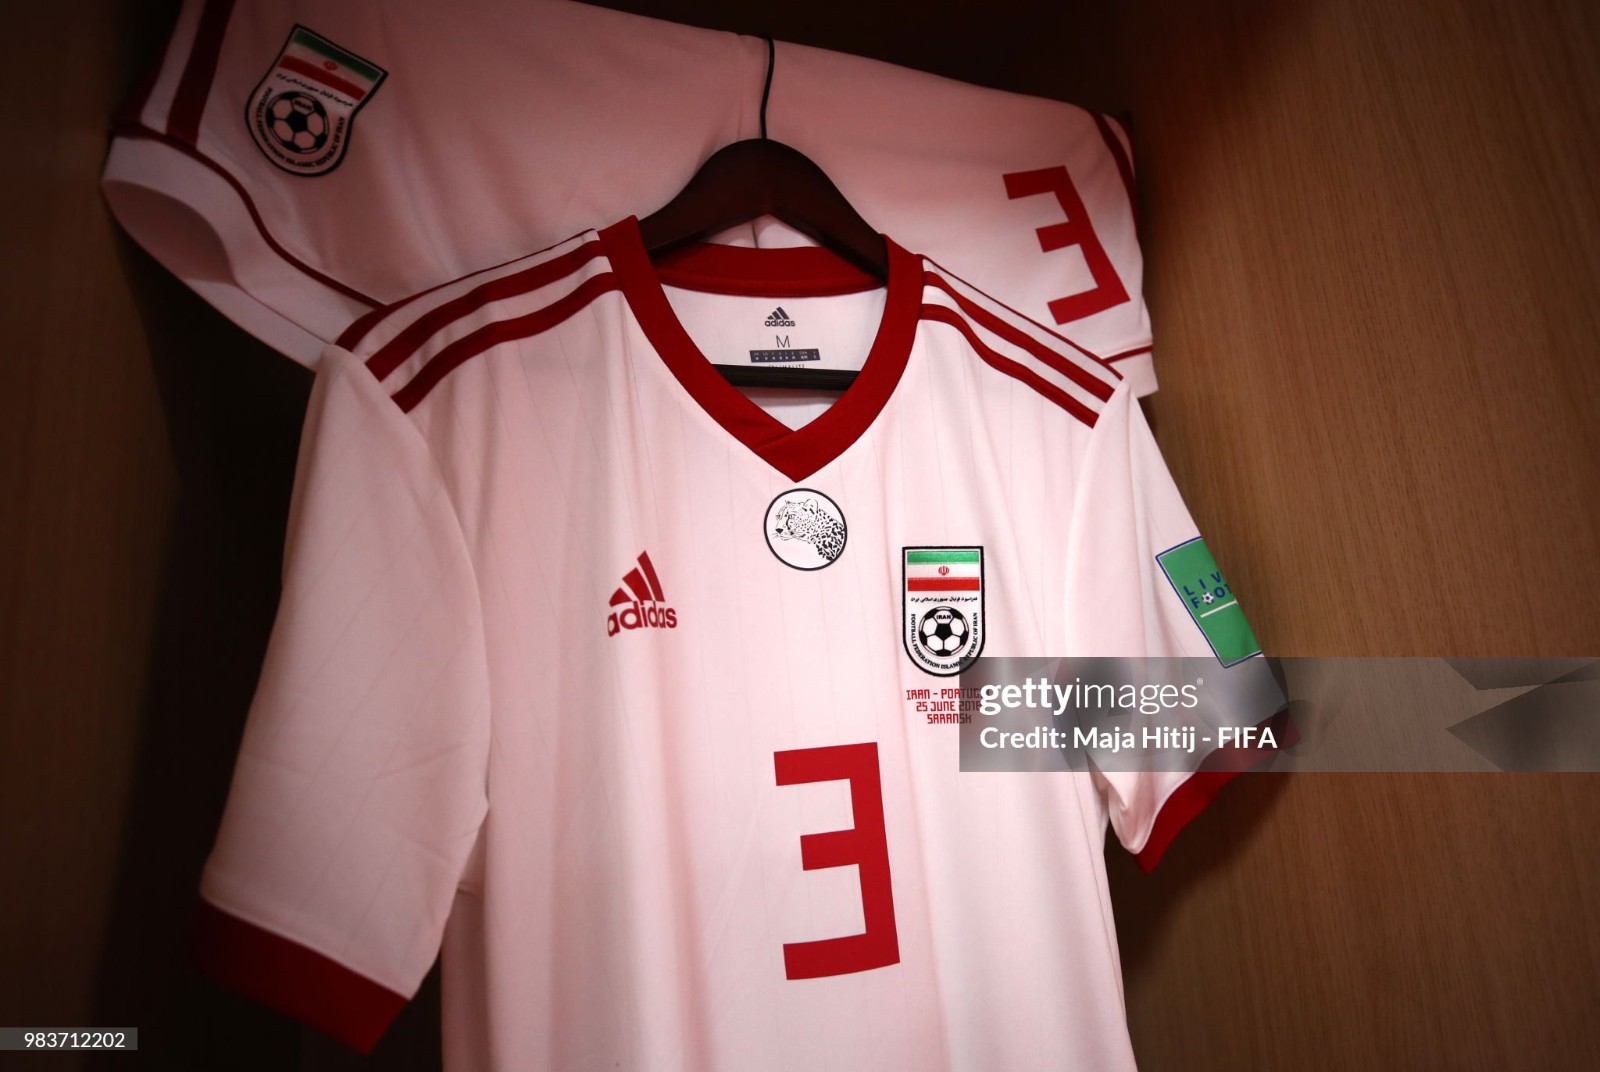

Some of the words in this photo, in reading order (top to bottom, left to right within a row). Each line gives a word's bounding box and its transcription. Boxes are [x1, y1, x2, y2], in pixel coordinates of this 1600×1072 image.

[1002, 165, 1131, 325] 3
[765, 319, 796, 327] adidas
[776, 334, 790, 348] M
[607, 600, 677, 637] adidas
[913, 643, 940, 669] FEDERATION
[906, 689, 930, 700] IRAN
[941, 688, 988, 699] PORTUG
[916, 701, 928, 712] 25
[930, 701, 955, 712] JUNE
[927, 713, 972, 724] SARANSK
[773, 741, 901, 981] 3
